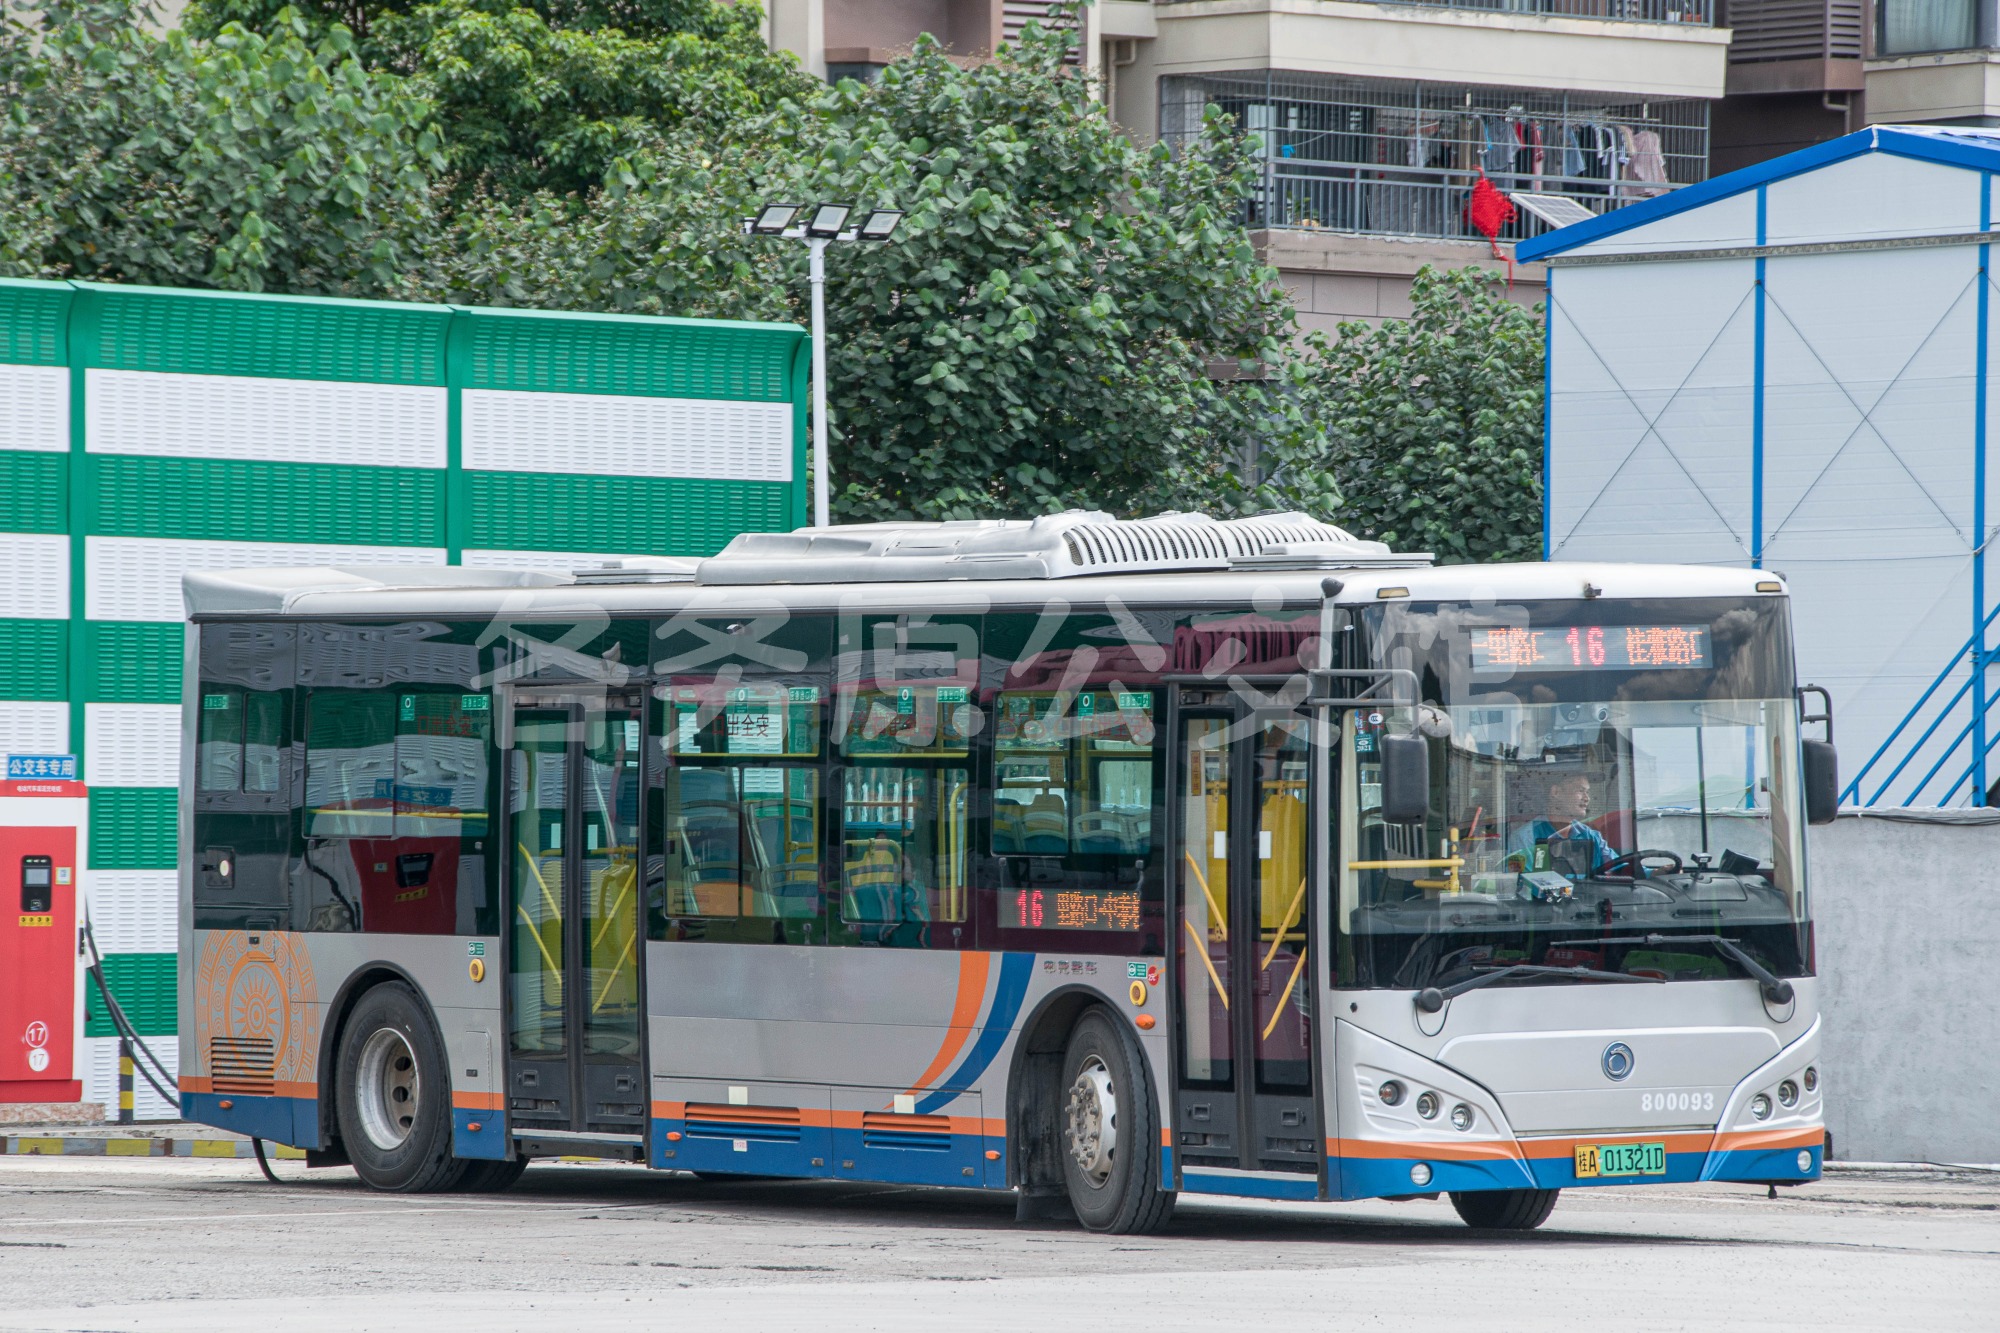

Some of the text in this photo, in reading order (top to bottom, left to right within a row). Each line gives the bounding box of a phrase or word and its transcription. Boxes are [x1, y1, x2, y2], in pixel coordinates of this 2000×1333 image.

[1566, 627, 1606, 666] 16
[9, 758, 73, 776] 公交车专用
[1017, 890, 1044, 927] 16
[28, 1027, 46, 1042] 17
[32, 1053, 45, 1066] 17
[1641, 1093, 1714, 1112] 800093
[1578, 1147, 1664, 1173] 桂A 01321D
